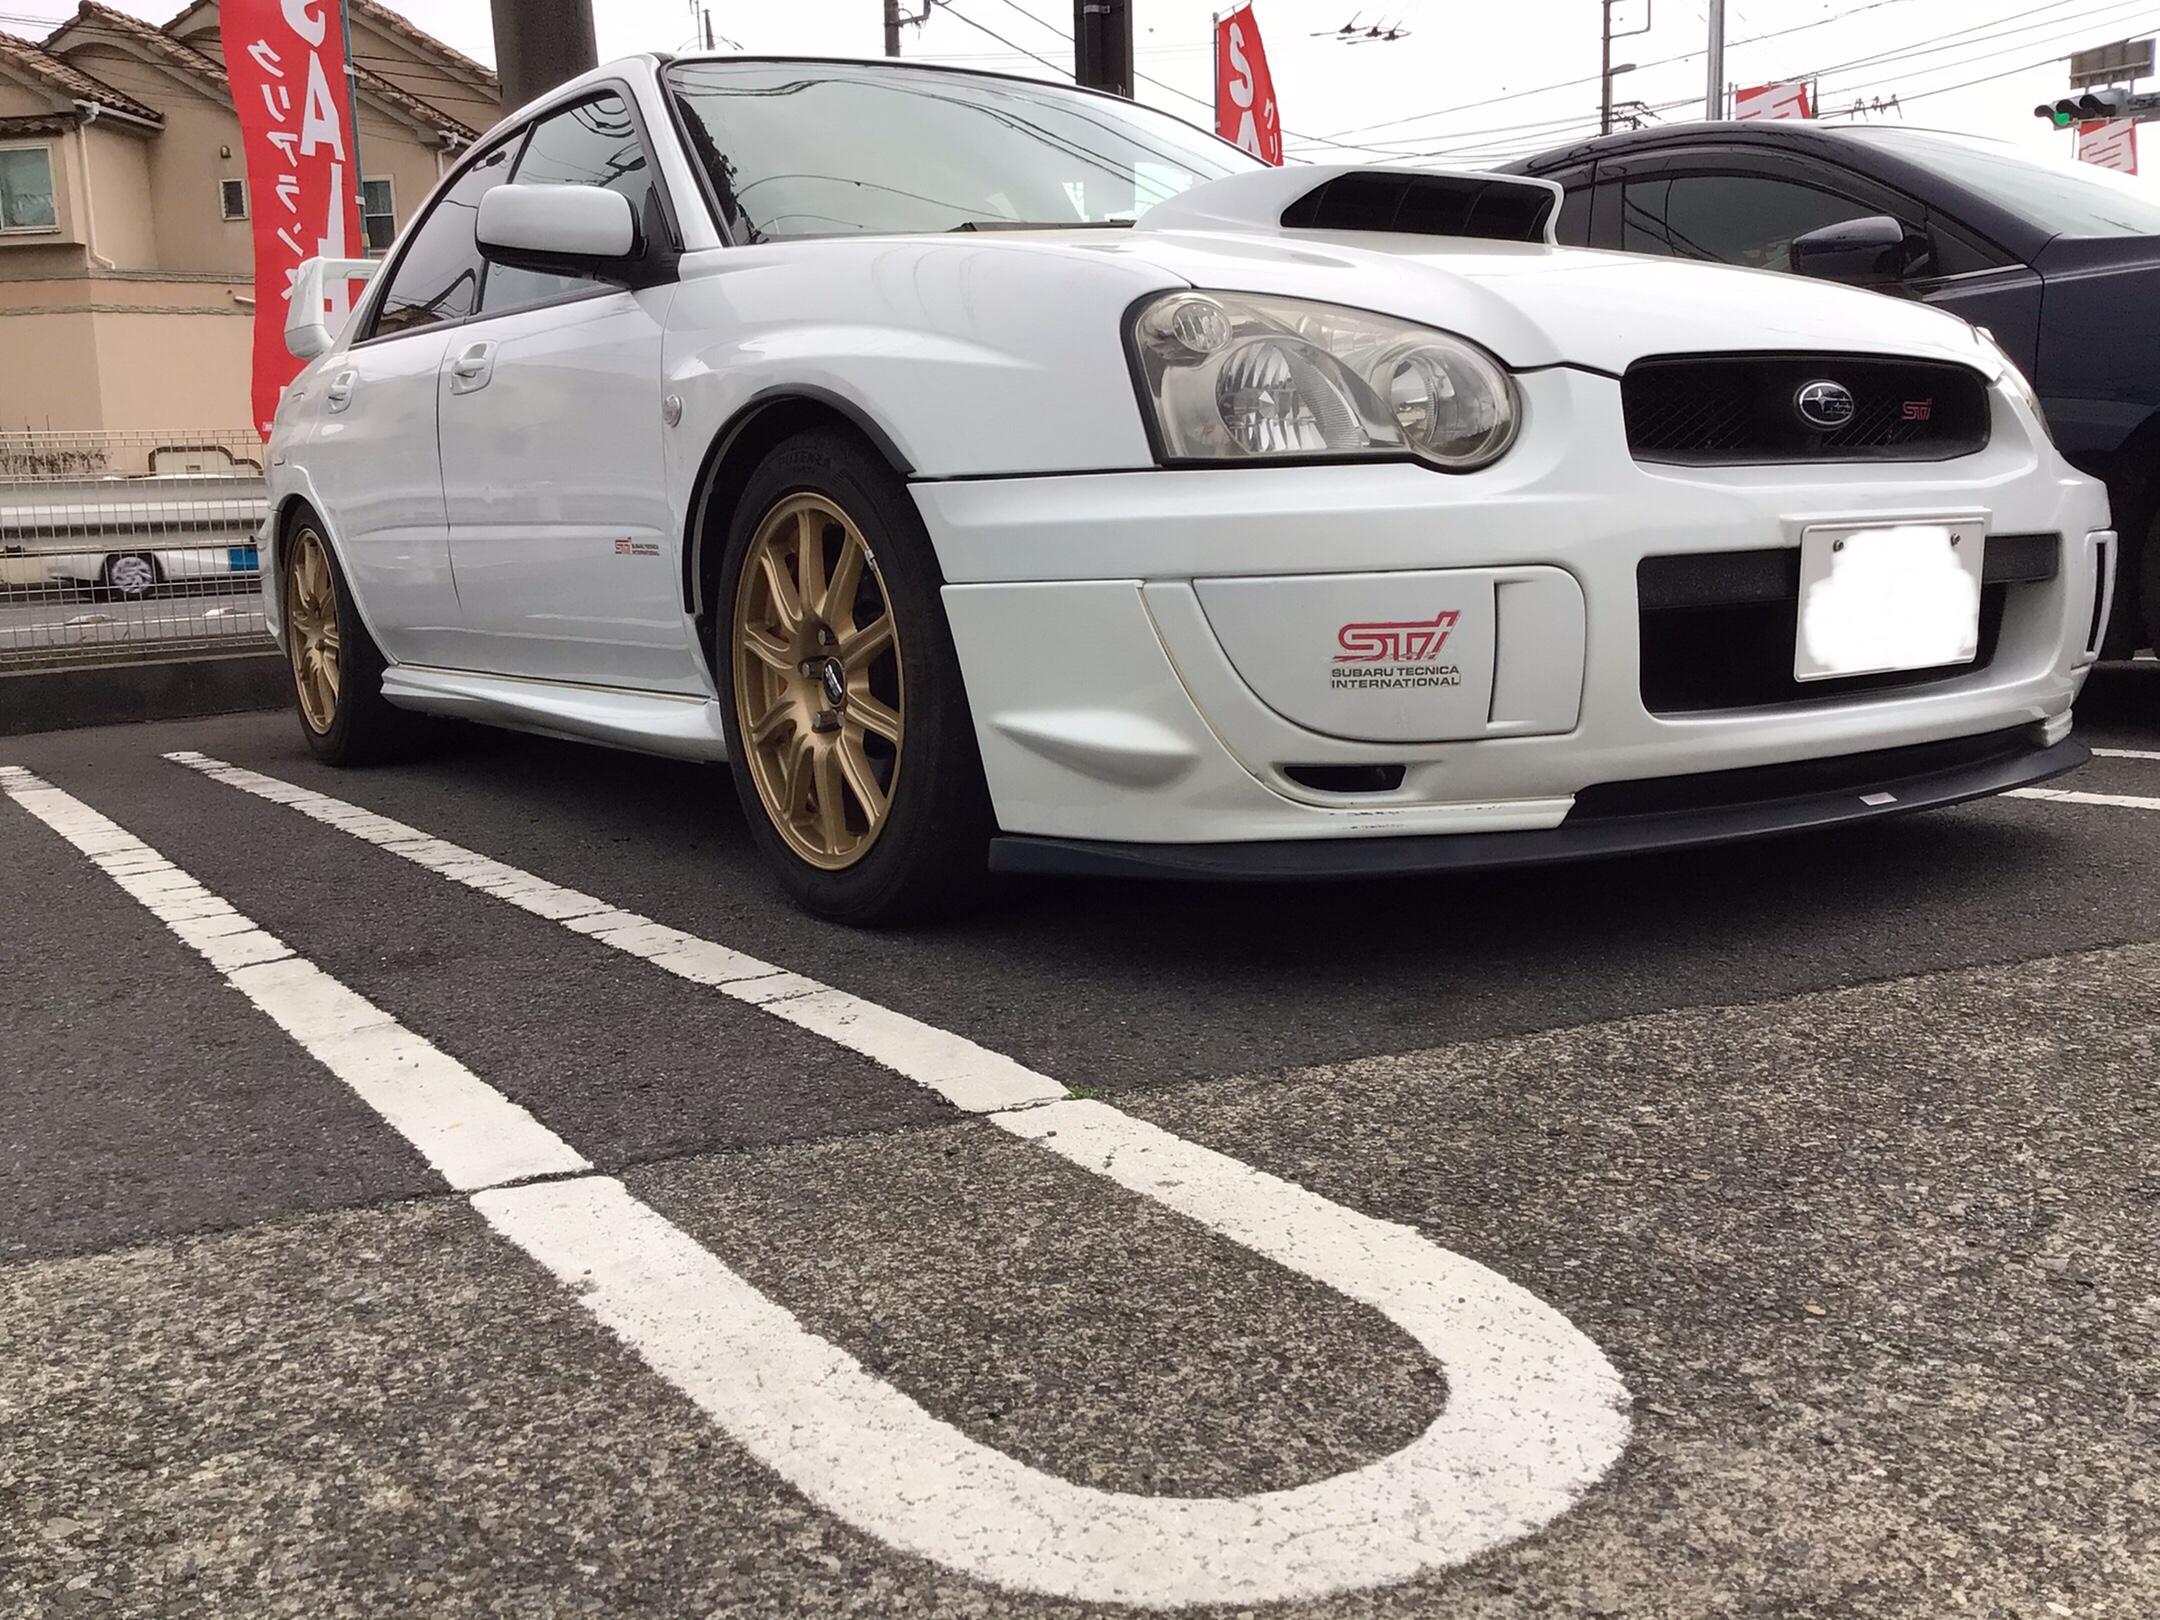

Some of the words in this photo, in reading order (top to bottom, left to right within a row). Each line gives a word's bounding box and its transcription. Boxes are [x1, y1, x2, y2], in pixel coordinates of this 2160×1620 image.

[1331, 668, 1394, 678] SUBARU
[1397, 665, 1460, 677] TECNICA
[1331, 676, 1461, 689] INTERNATIONAL
